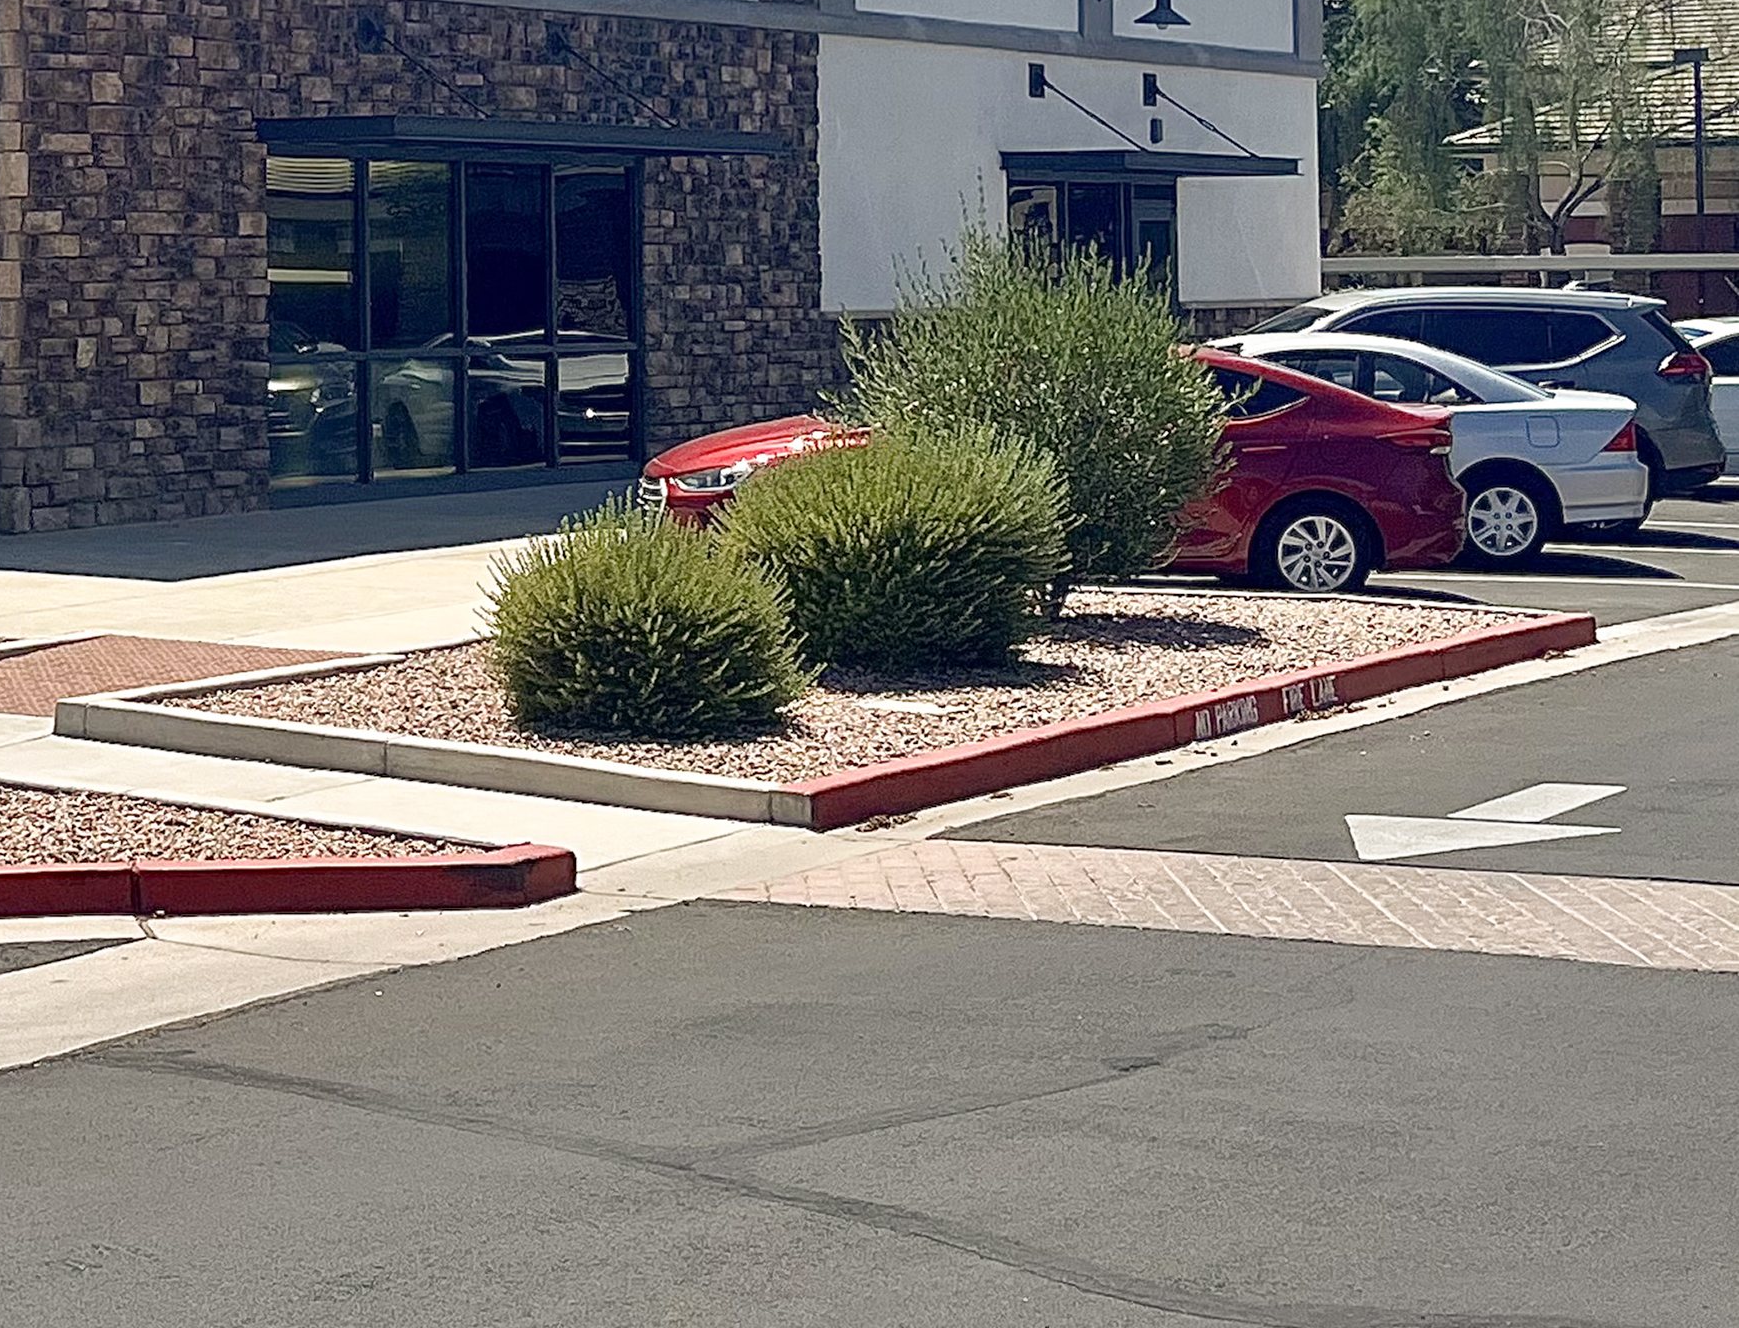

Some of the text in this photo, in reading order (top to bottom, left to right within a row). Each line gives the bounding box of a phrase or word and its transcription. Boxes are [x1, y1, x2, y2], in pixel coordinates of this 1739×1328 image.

[1195, 675, 1339, 739] NO PARKING FIRE LANE
